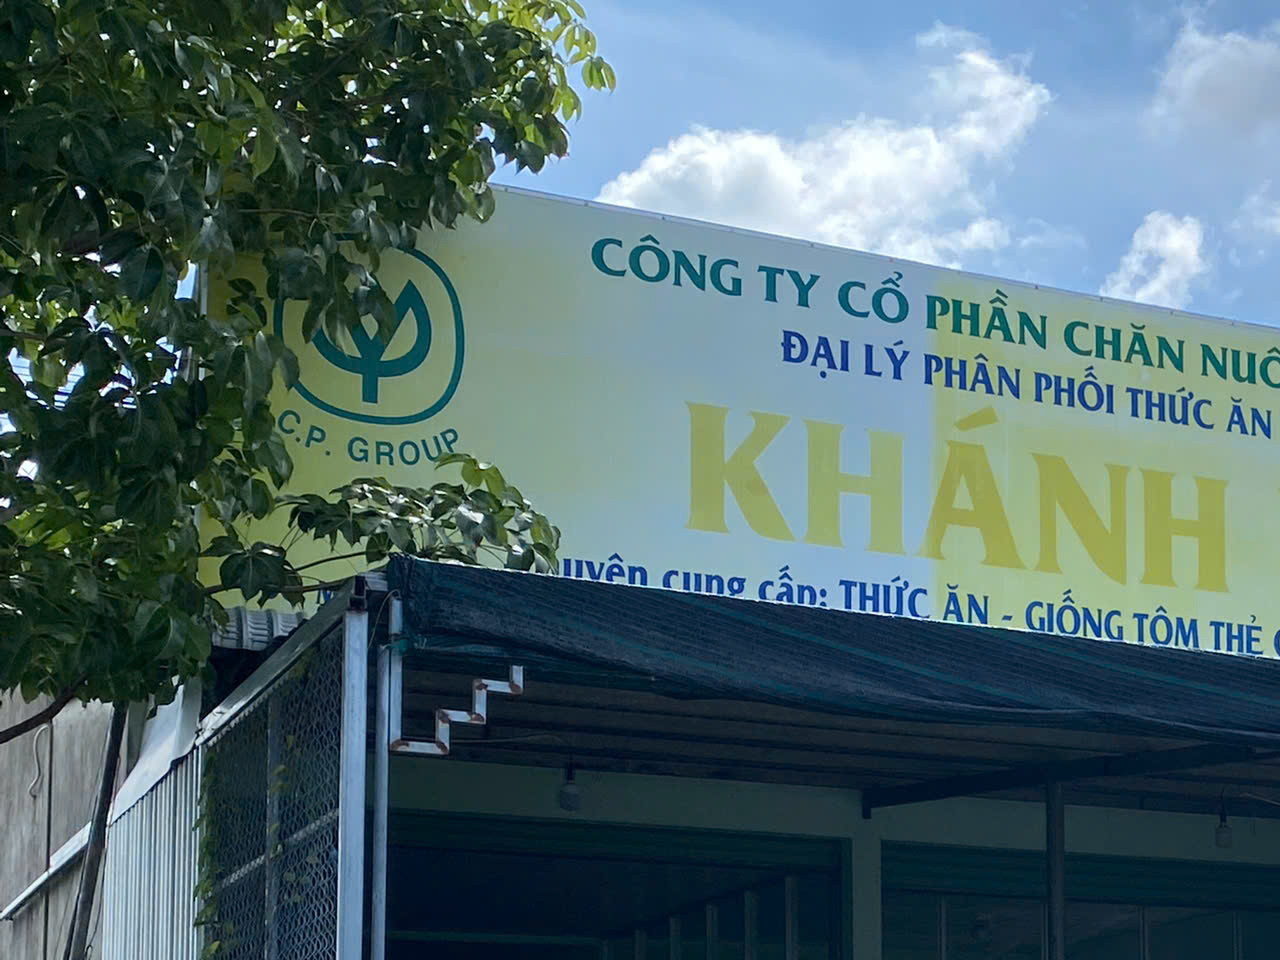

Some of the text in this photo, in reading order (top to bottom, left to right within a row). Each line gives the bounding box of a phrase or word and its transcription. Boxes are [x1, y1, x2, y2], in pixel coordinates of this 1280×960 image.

[590, 234, 743, 297] CÔNG
[757, 264, 820, 309] TY
[838, 270, 910, 325] CỔ
[925, 289, 1048, 350] PHẦN
[1064, 323, 1185, 373] CHĂN
[780, 330, 850, 379] ĐẠI
[863, 338, 910, 382] LÝ
[923, 352, 1021, 400] PHÂN
[1034, 364, 1115, 415] PHỐI
[1126, 386, 1216, 430] THỨC
[1226, 397, 1273, 440] ĂN
[348, 427, 460, 466] GROUP
[684, 401, 1231, 593] KHÁNH
[562, 553, 648, 587] uyên
[839, 578, 929, 619] THỨC
[943, 585, 989, 625] ĂN
[1025, 588, 1124, 640] GIỐNG
[1133, 606, 1200, 649] TÔM
[1210, 615, 1263, 653] THẺ
